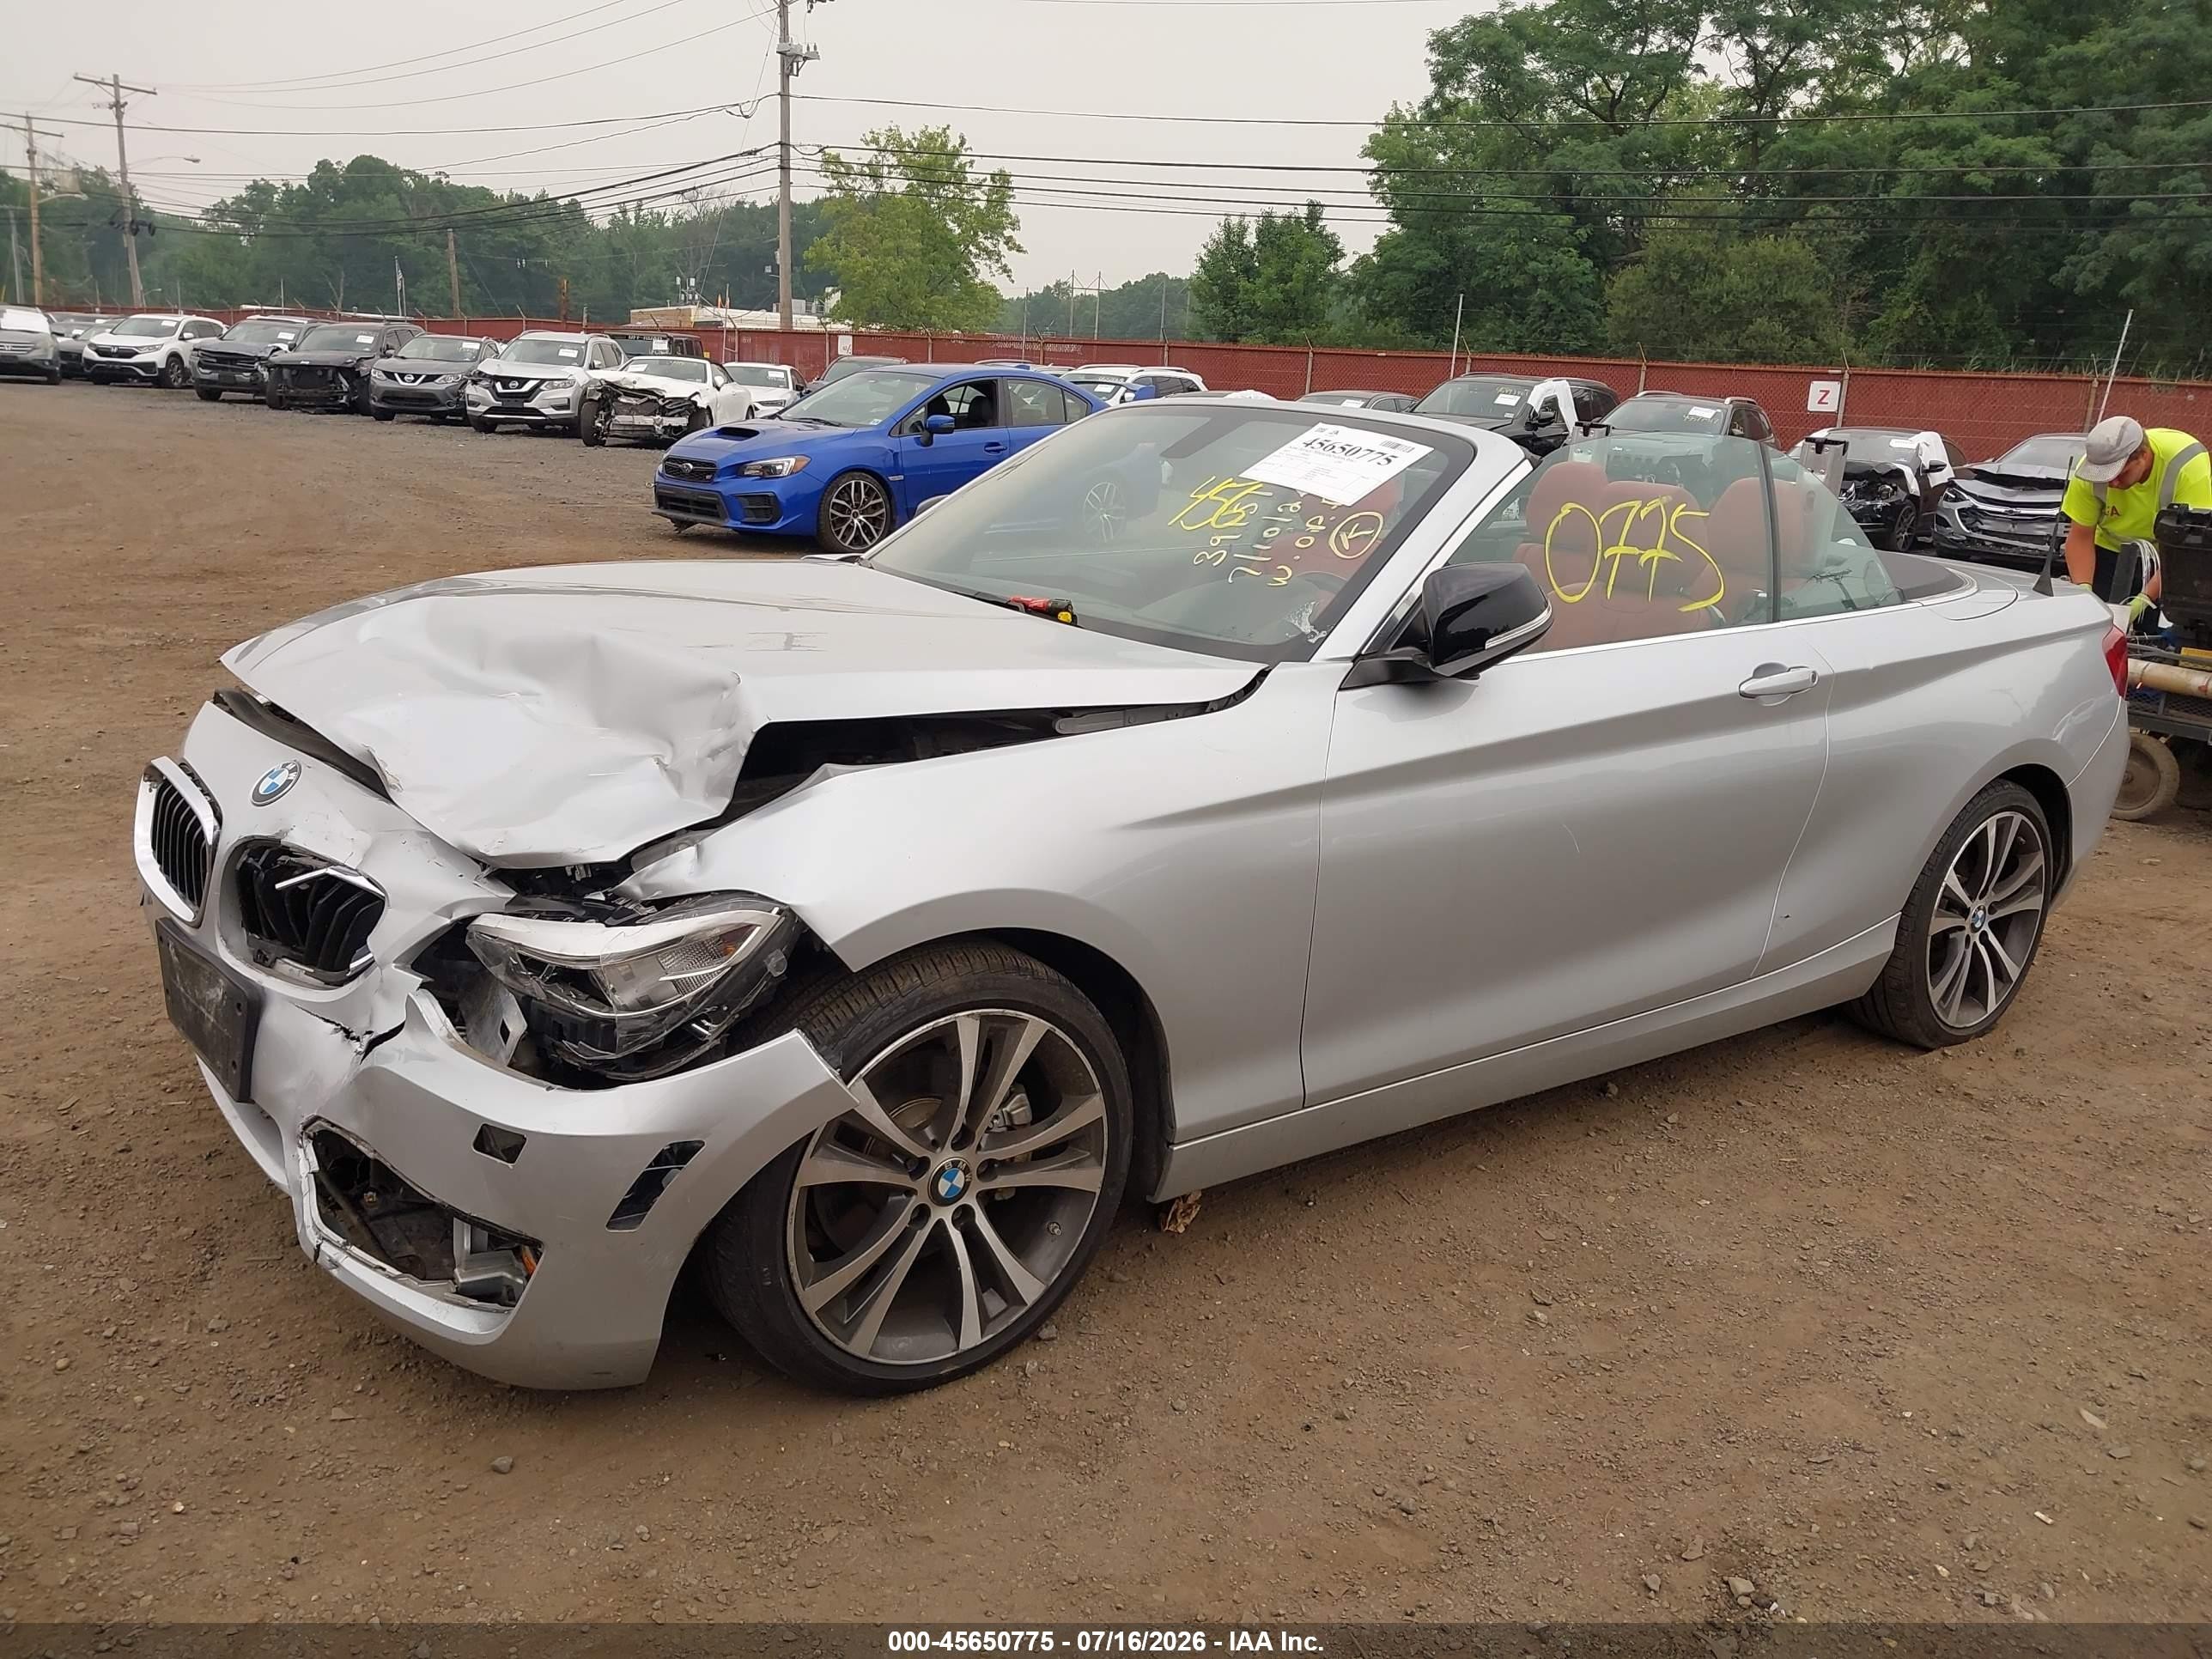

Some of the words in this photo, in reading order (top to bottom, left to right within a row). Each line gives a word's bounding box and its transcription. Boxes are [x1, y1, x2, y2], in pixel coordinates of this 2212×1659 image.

[1817, 389, 1831, 405] Z
[1302, 437, 1399, 466] 45650775
[1546, 495, 1724, 613] 0775
[945, 1161, 972, 1182] BMW
